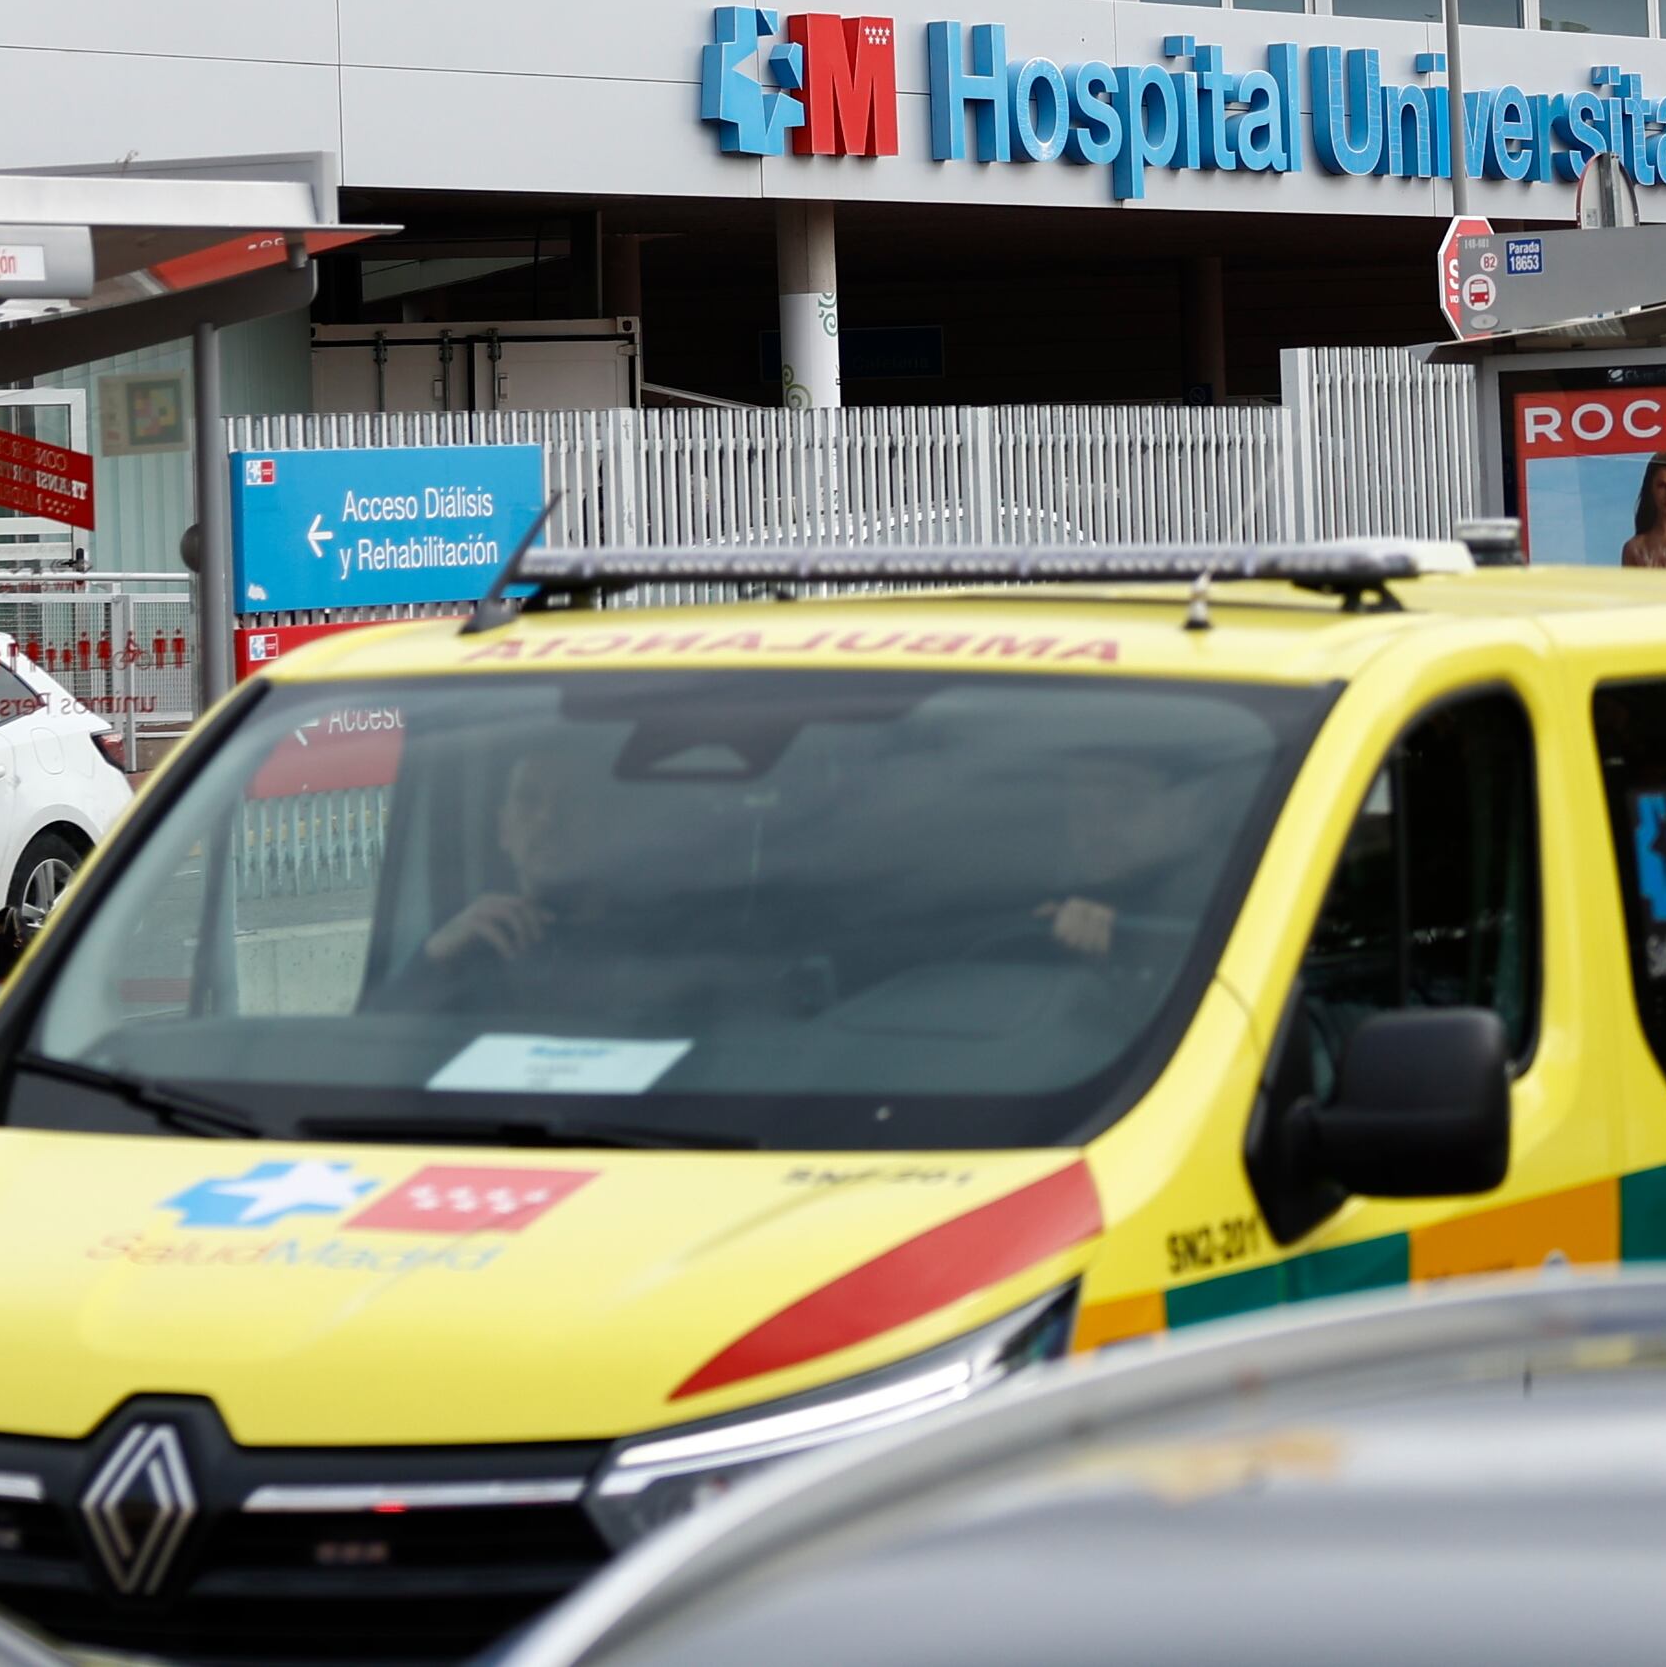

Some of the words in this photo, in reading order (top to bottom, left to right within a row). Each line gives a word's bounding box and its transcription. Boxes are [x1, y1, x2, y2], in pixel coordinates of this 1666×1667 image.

[928, 20, 1300, 199] Hospital
[1509, 241, 1540, 255] Parada
[1509, 254, 1540, 271] 18653
[342, 490, 418, 522] Acceso
[424, 486, 494, 520] Diálisis
[339, 548, 351, 580] y
[358, 534, 498, 571] Rehabilitación
